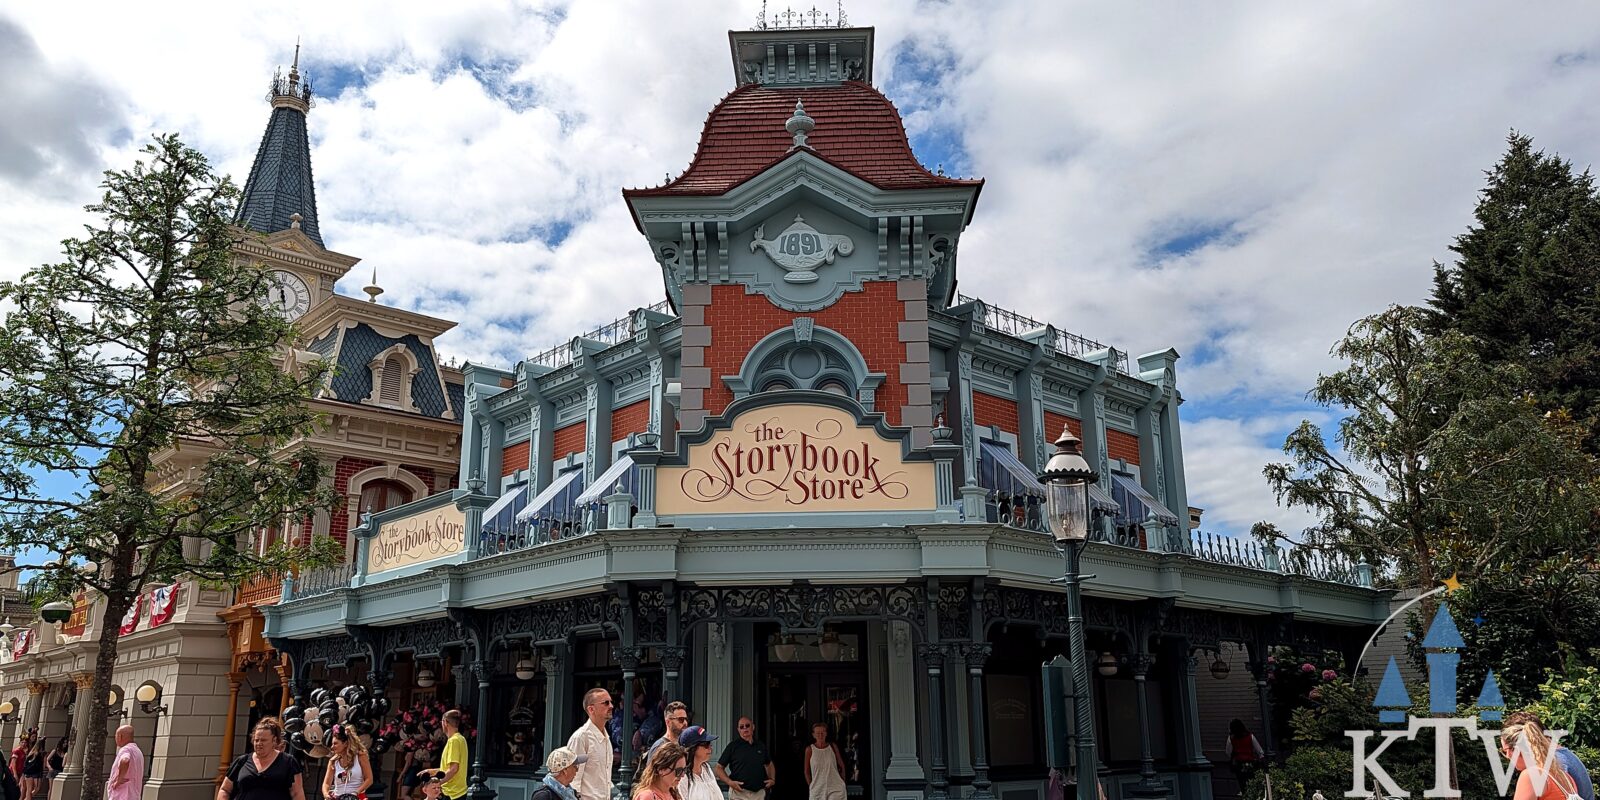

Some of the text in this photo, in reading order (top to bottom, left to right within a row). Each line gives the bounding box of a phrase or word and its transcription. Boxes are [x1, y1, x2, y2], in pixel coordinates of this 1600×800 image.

[779, 233, 823, 255] 1891
[748, 418, 793, 442] the
[681, 419, 908, 502] Storybook
[785, 470, 864, 505] Store
[372, 511, 464, 567] Storybook Store
[387, 525, 401, 538] the
